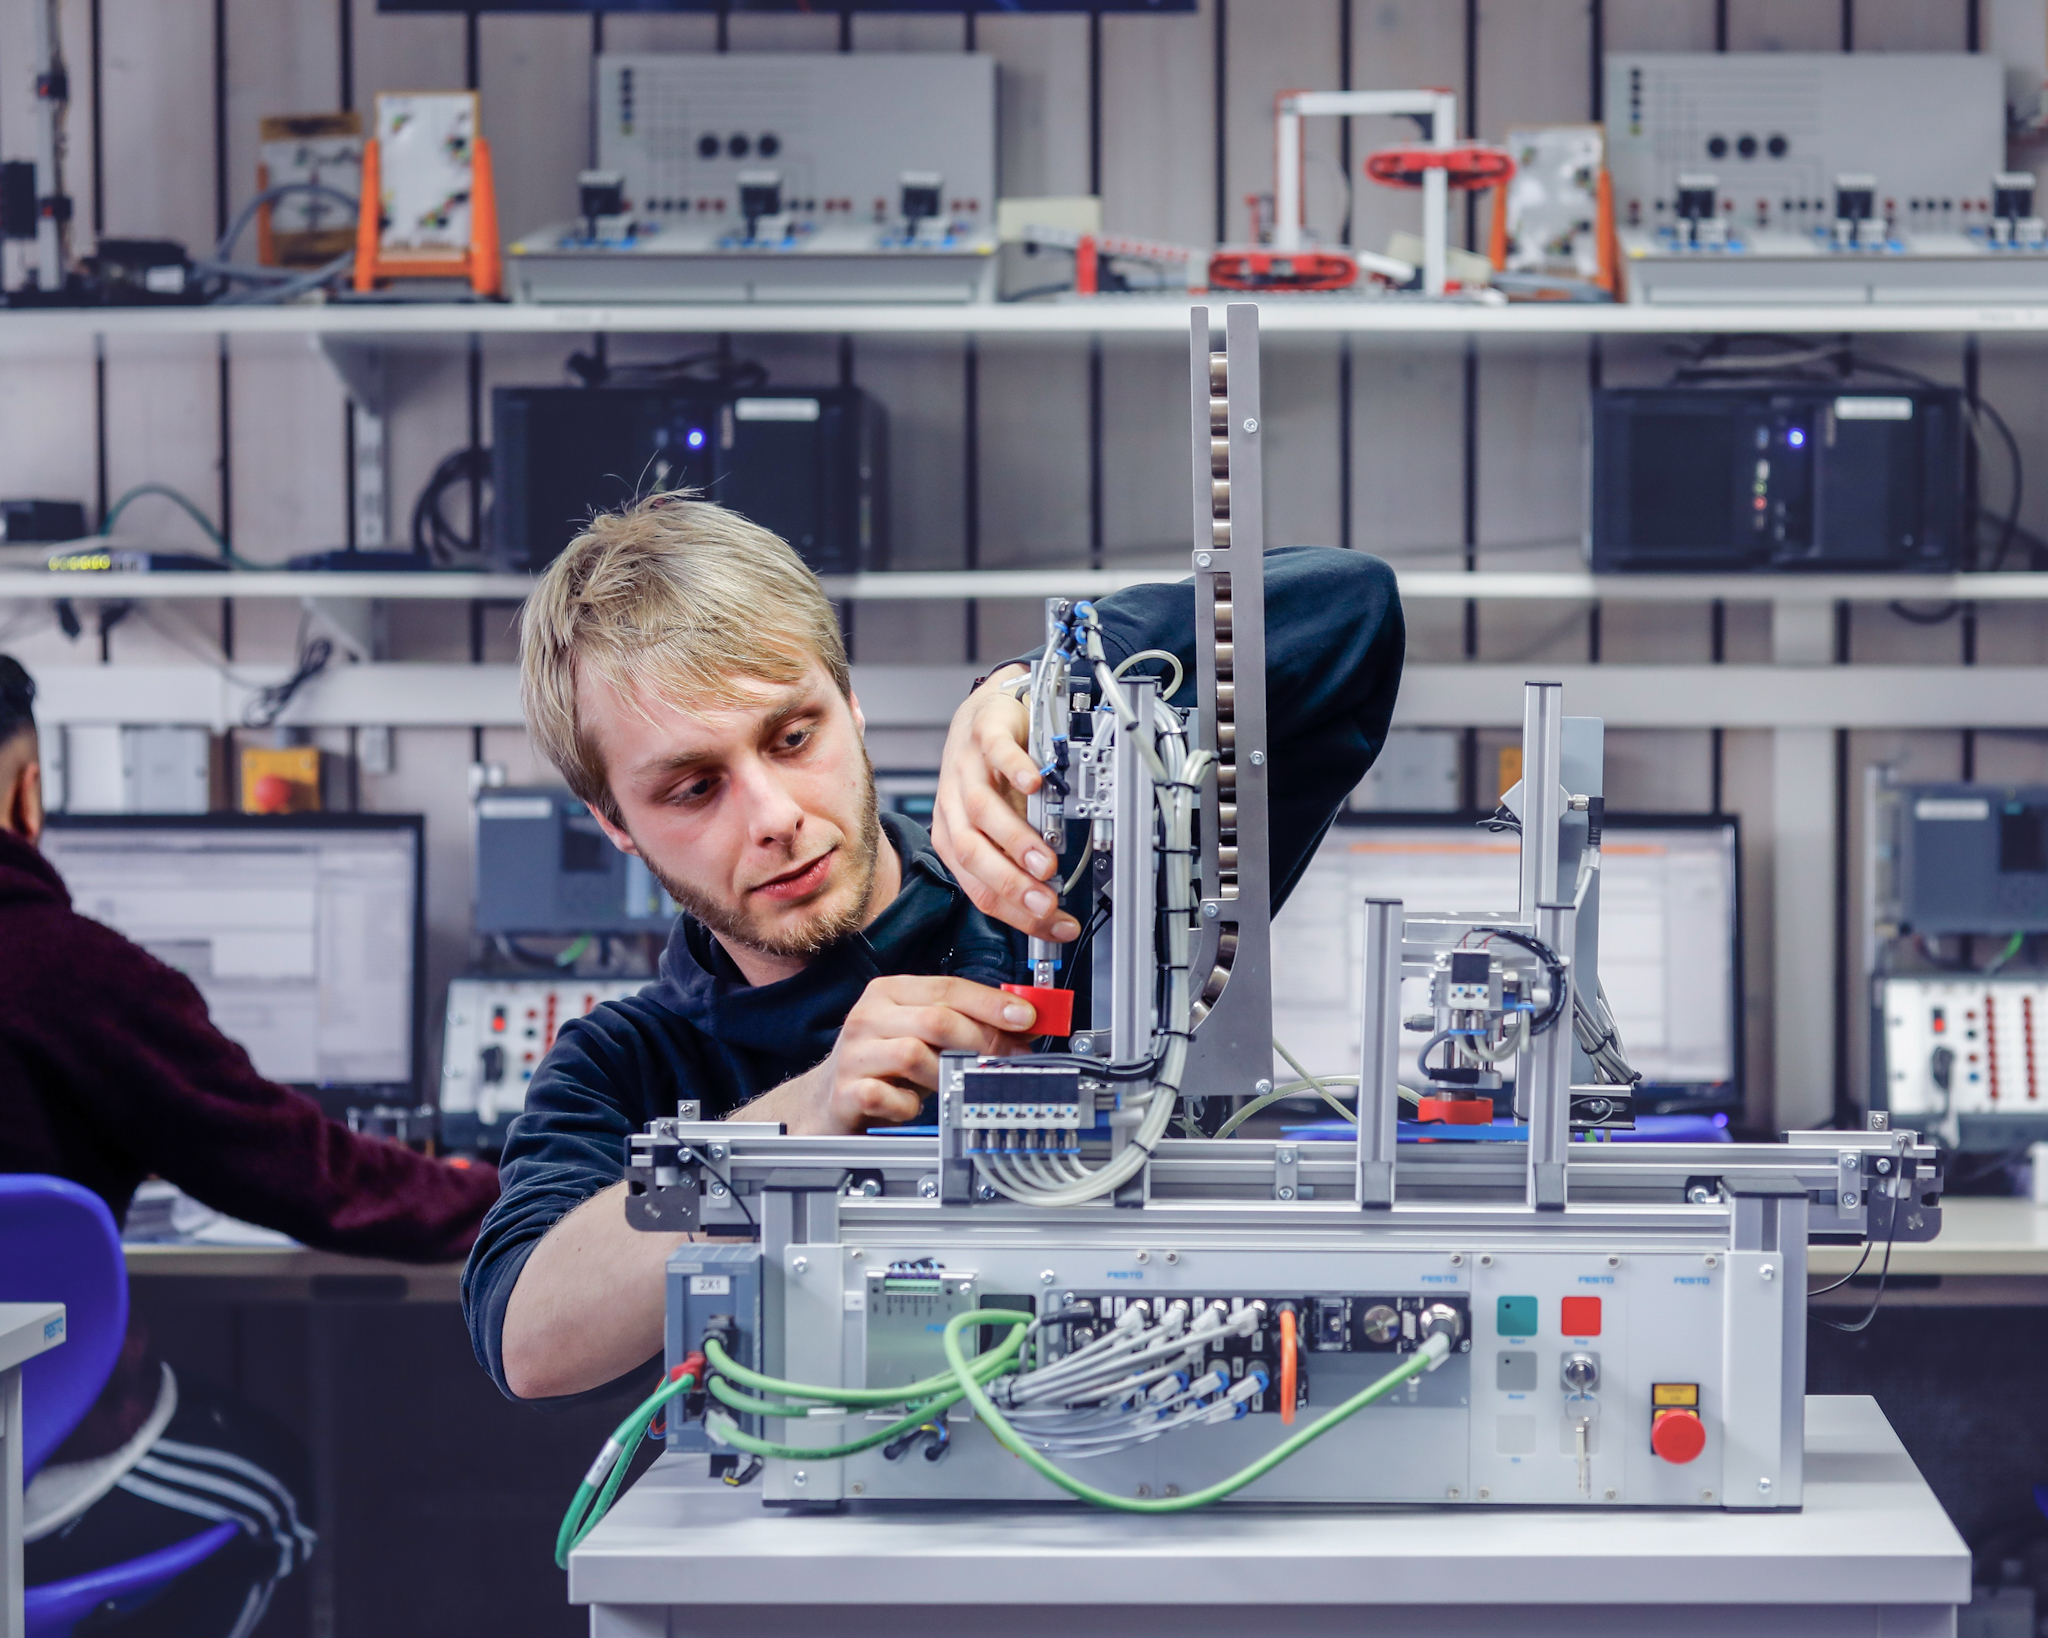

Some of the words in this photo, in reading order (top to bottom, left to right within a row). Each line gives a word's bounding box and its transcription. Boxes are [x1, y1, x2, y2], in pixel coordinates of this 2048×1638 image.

[1106, 1270, 1144, 1279] FESTO
[1421, 1274, 1458, 1283] FESTO
[699, 1279, 721, 1291] 2X1
[1578, 1276, 1615, 1285] FESTO
[1673, 1277, 1710, 1286] FESTO
